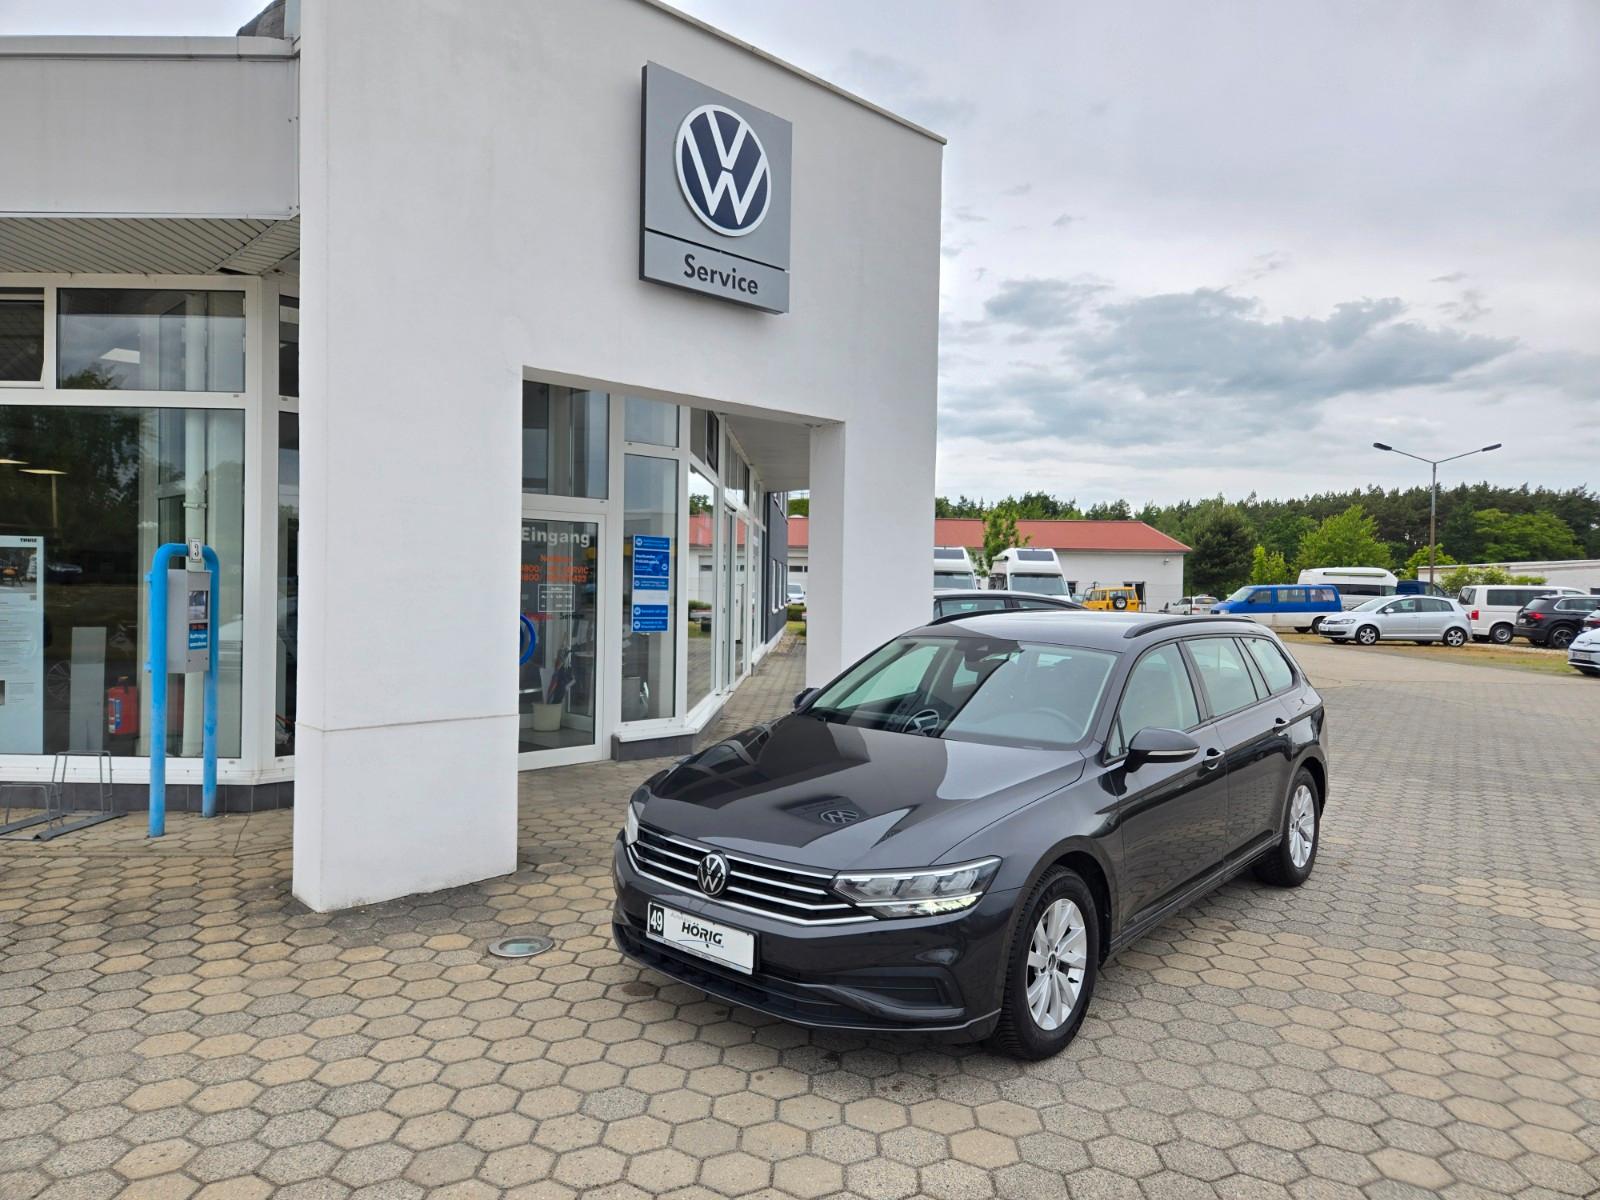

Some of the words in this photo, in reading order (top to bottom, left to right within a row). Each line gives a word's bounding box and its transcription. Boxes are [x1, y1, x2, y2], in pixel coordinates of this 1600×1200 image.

[676, 105, 771, 236] VW
[683, 253, 759, 295] Service
[521, 526, 590, 548] Eingang
[698, 853, 726, 895] VW
[650, 909, 663, 932] 49
[681, 921, 723, 948] HÖRIG
